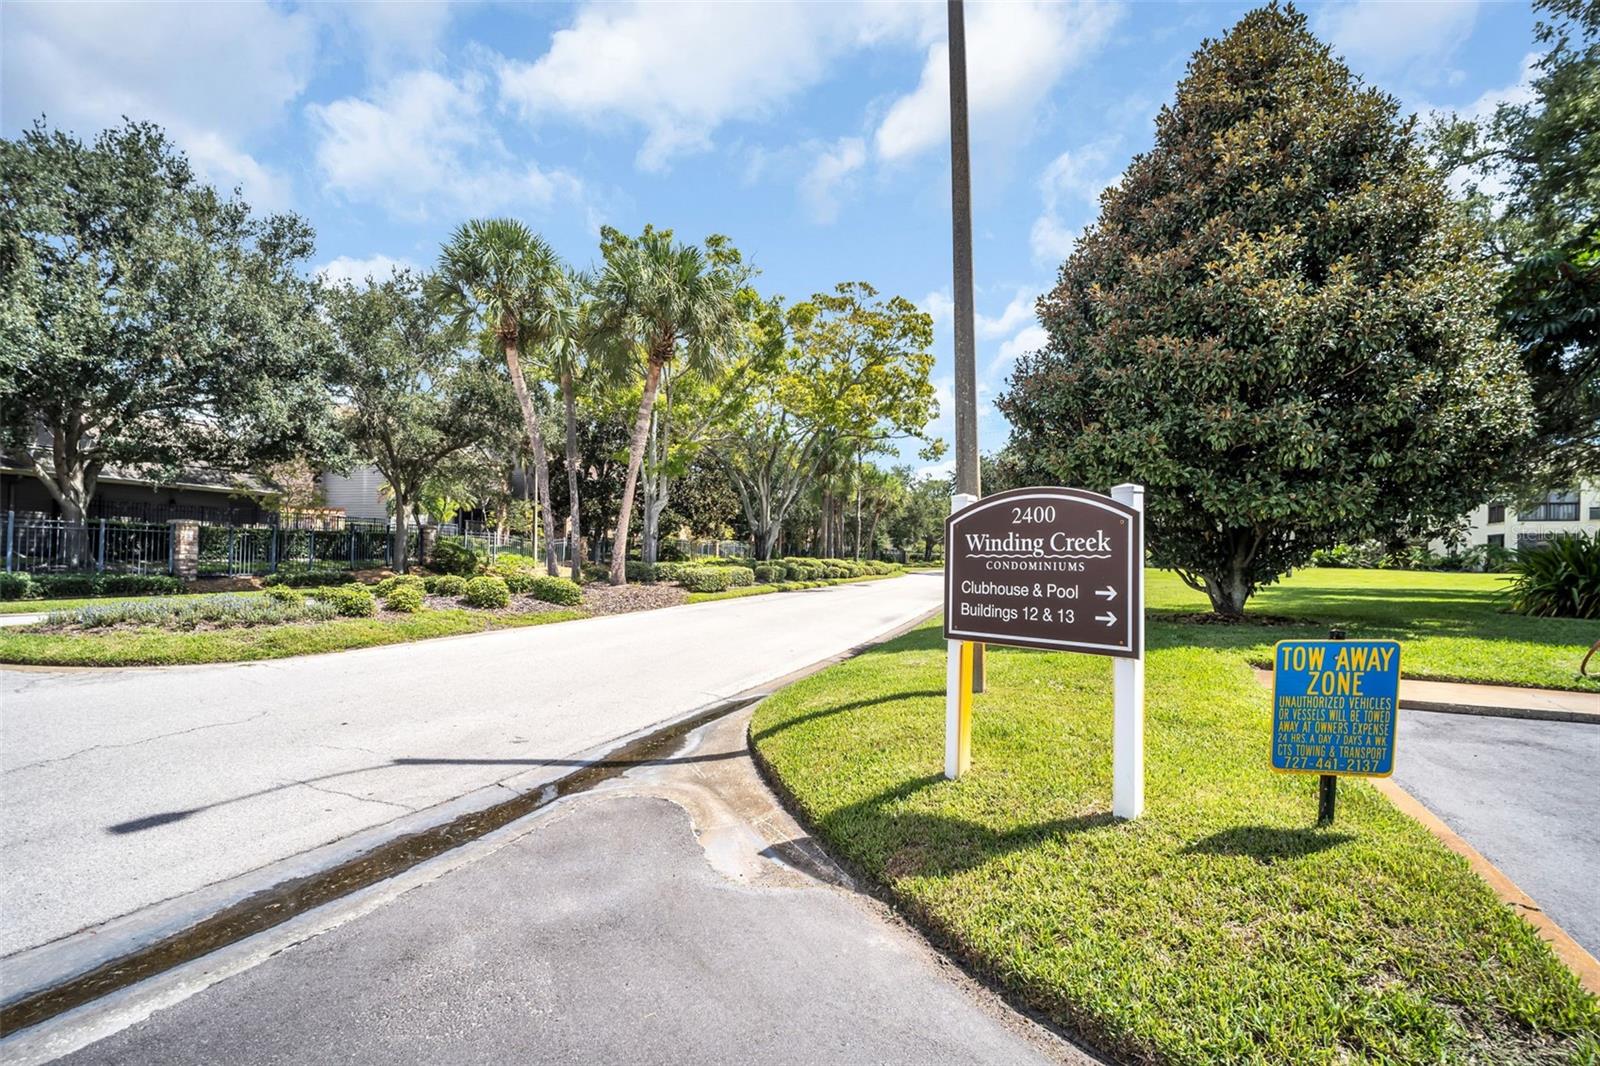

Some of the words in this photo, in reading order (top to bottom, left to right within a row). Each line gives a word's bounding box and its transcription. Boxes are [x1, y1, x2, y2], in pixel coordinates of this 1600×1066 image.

[1012, 506, 1055, 524] 2400
[965, 532, 1044, 557] Winding
[1050, 530, 1112, 552] Creek
[986, 561, 1084, 571] CONDOMINIUMS
[961, 581, 1028, 596] Clubhouse
[1033, 584, 1042, 597] &
[1047, 584, 1078, 599] Pool
[961, 603, 1018, 621] Buildings
[1023, 607, 1038, 620] 12
[1043, 608, 1053, 622] &
[1058, 609, 1074, 623] 13
[1282, 647, 1325, 671] TOW
[1336, 647, 1395, 671] AWAY
[1306, 671, 1364, 696] ZONE
[1279, 697, 1345, 709] UNAUTHORIZED
[1349, 698, 1391, 710] VEHICLES
[1279, 709, 1288, 719] OR
[1293, 709, 1325, 720] VESSELS
[1329, 710, 1346, 722] WILL
[1350, 710, 1359, 722] BE
[1364, 710, 1390, 722] TOWED
[1278, 721, 1298, 732] AWAY
[1302, 722, 1310, 732] AT
[1315, 722, 1348, 734] OWNERS
[1352, 723, 1389, 735] EXPENSE
[1278, 734, 1287, 742] 24
[1319, 735, 1332, 743] DAY
[1336, 735, 1340, 744] 7
[1344, 736, 1362, 745] DAYS
[1366, 737, 1371, 745] A
[1278, 745, 1292, 755] CTS
[1297, 745, 1326, 756] TOWING
[1329, 746, 1335, 756] &
[1340, 746, 1386, 760] TRANSPORT
[1285, 757, 1379, 772] 727-441-2137
